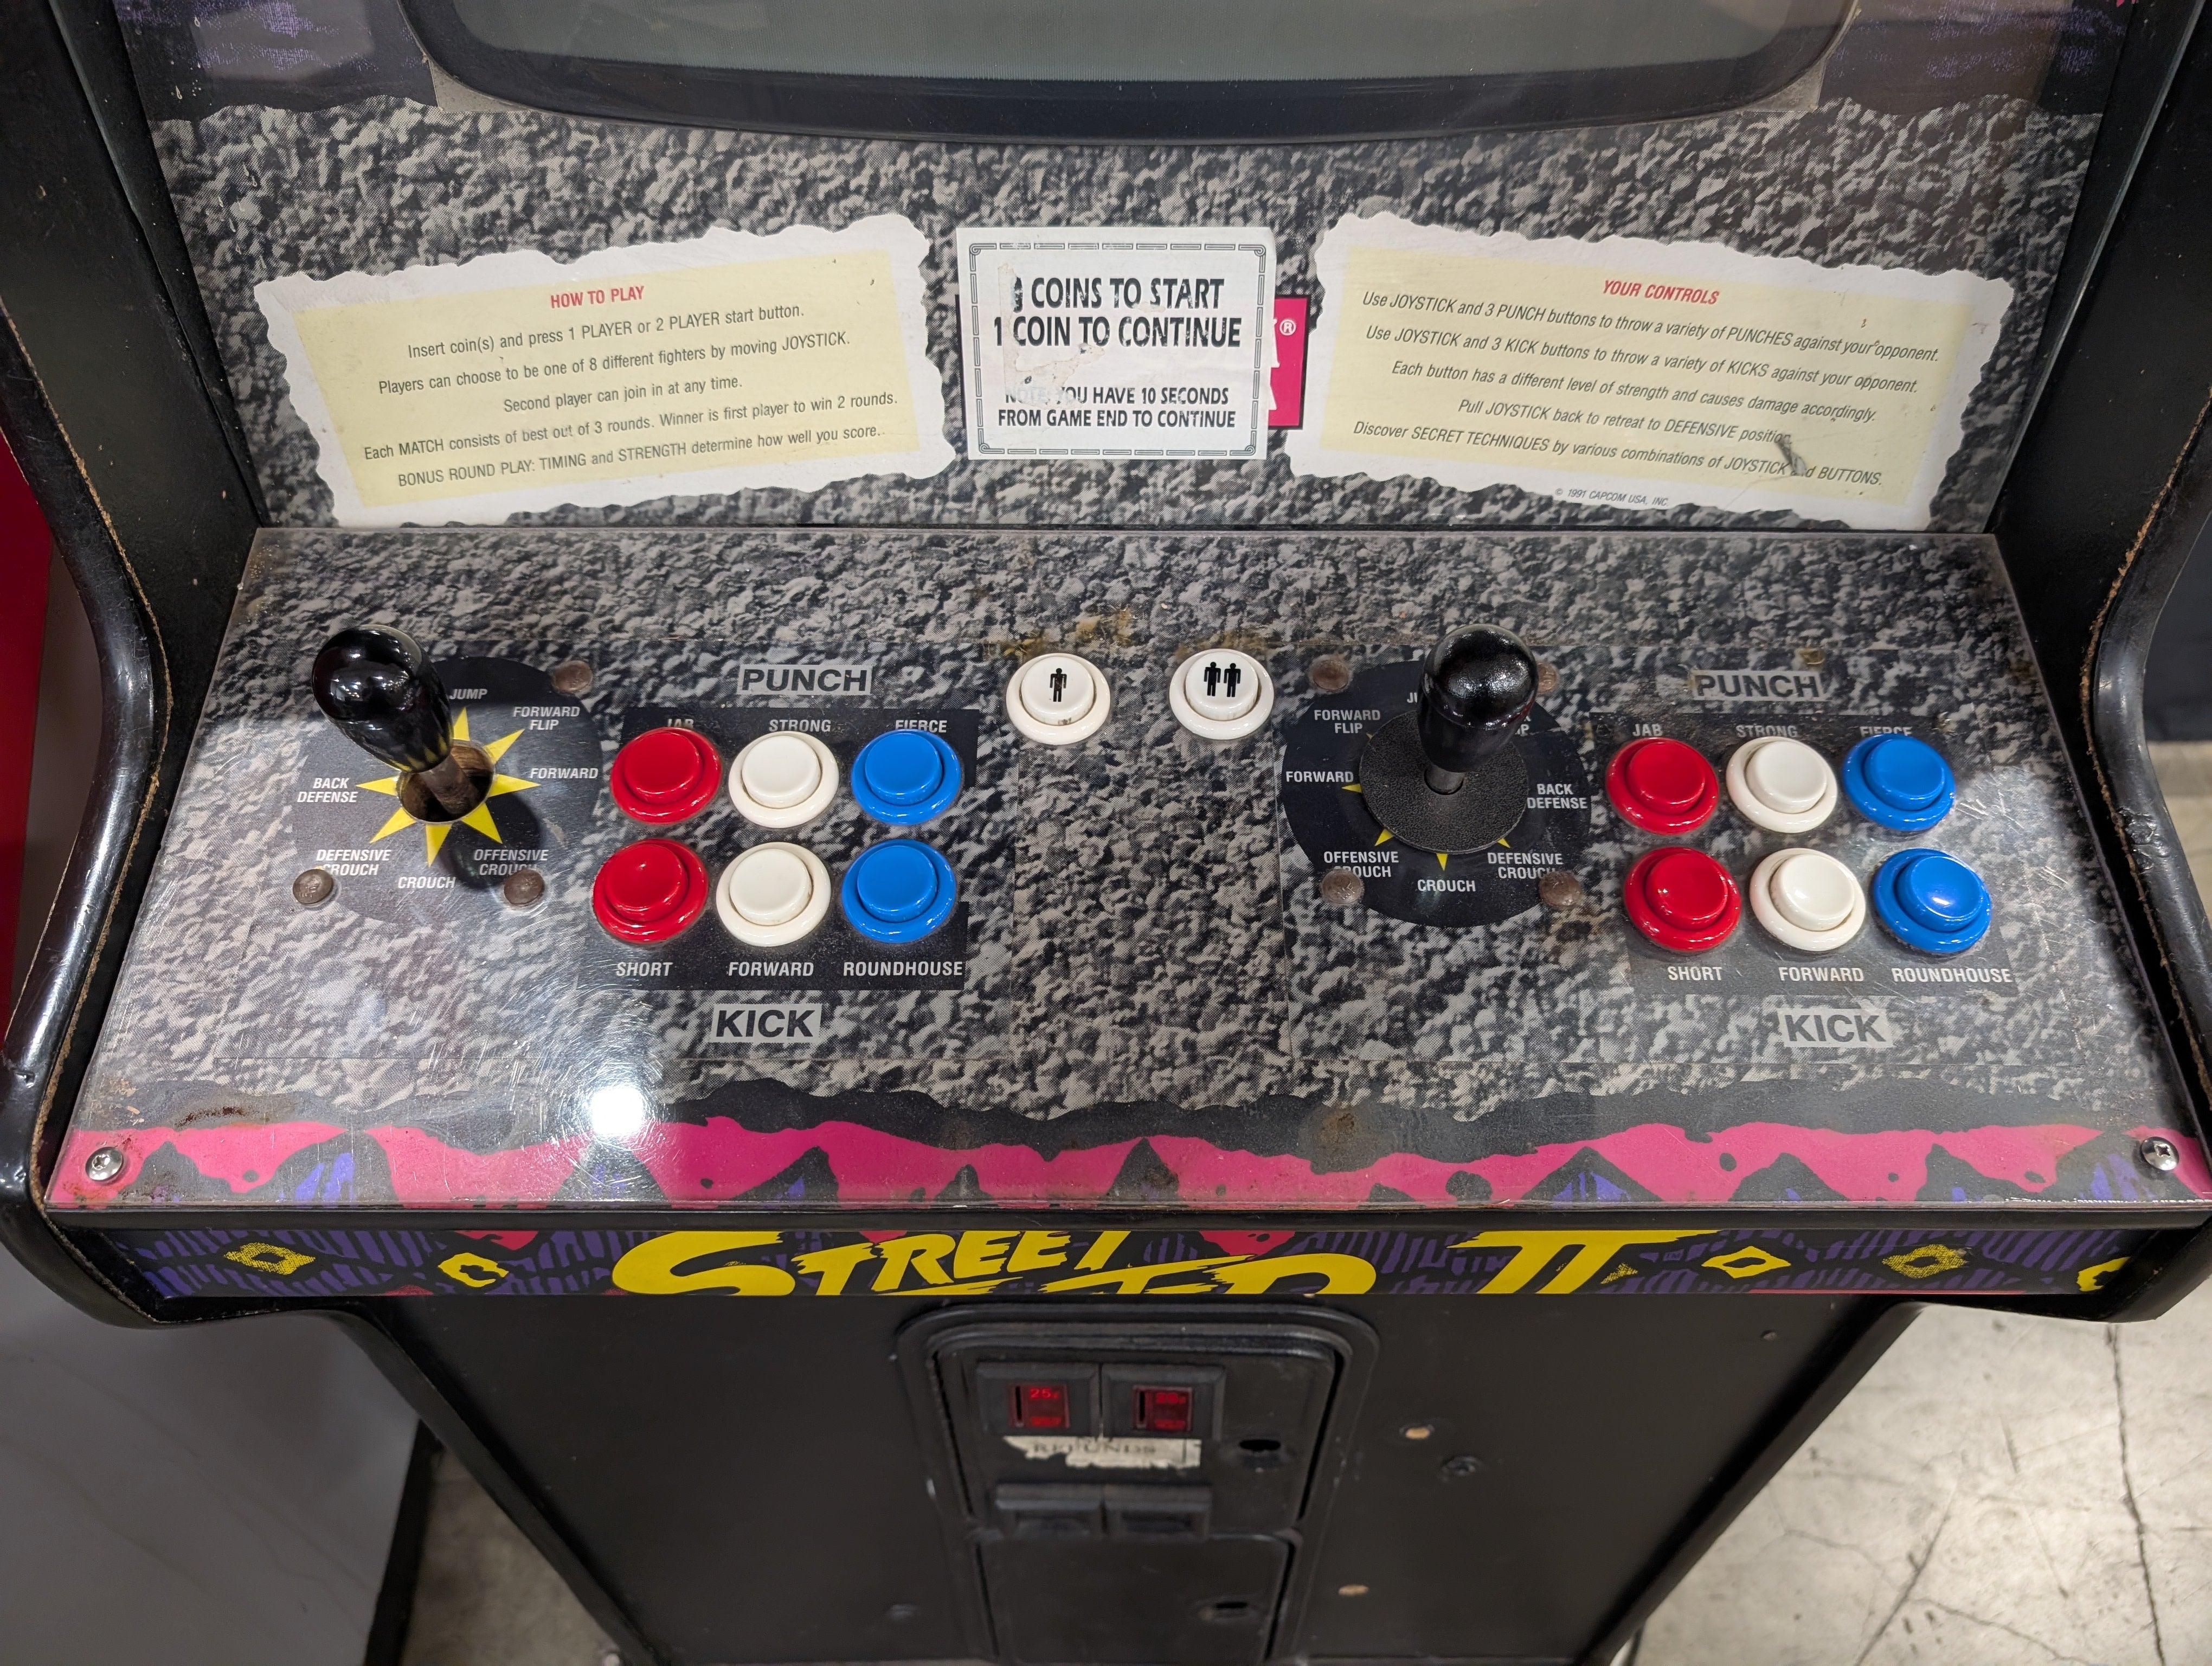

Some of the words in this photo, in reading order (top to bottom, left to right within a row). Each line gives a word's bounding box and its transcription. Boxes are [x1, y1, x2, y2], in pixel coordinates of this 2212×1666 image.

[551, 292, 583, 308] HOW
[587, 290, 605, 304] TO
[610, 286, 644, 302] PLAY
[1031, 277, 1102, 309] COINS
[1110, 278, 1140, 309] TO
[1149, 278, 1225, 309] START
[1603, 280, 1642, 297] YOUR
[1644, 284, 1719, 304] CONTROLS
[408, 342, 446, 358] Insert
[451, 336, 494, 353] coin(s)
[500, 333, 523, 348] and
[529, 331, 563, 348] press
[569, 327, 574, 340] 1
[582, 321, 632, 338] PLAYER
[638, 322, 651, 333] or
[657, 318, 664, 331] 2
[670, 312, 719, 330] PLAYER
[725, 309, 754, 324] start
[759, 306, 803, 320] button.
[994, 316, 1002, 347] 1
[1013, 316, 1071, 347] COIN
[1078, 316, 1110, 347] TO
[1118, 316, 1241, 348] CONTINUE
[1363, 291, 1387, 306] Use
[1390, 294, 1457, 313] JOYSTICK
[1457, 302, 1484, 315] and
[1485, 303, 1495, 316] 3
[1496, 304, 1546, 321] PUNCH
[1547, 309, 1597, 326] buttons
[1599, 315, 1612, 328] to
[1615, 316, 1654, 331] throw
[1654, 323, 1663, 332] a
[1666, 323, 1709, 340] variety
[1711, 326, 1727, 339] of
[1726, 327, 1793, 346] PUNCHES
[1793, 336, 1842, 351] against
[1841, 341, 1874, 356] your
[1875, 343, 1939, 362] opponent.
[379, 380, 424, 395] Players
[429, 377, 451, 388] can
[457, 371, 501, 386] choose
[506, 368, 518, 380] to
[524, 366, 538, 377] be
[544, 364, 567, 376] one
[573, 359, 584, 373] of
[589, 358, 597, 370] 8
[603, 353, 654, 369] different
[658, 349, 705, 366] fighters
[711, 345, 725, 360] by
[731, 340, 776, 356] moving
[782, 331, 850, 350] JOYSTICK.
[504, 395, 550, 412] Second
[556, 393, 592, 409] player
[597, 390, 619, 402] can
[625, 386, 646, 402] join
[652, 383, 663, 396] in
[668, 382, 679, 394] at
[684, 382, 706, 394] any
[711, 377, 742, 389] time.
[1093, 387, 1135, 405] HAVE
[1141, 387, 1156, 405] 10
[1161, 387, 1229, 405] SECONDS
[1392, 361, 1423, 376] Each
[1426, 364, 1468, 380] button
[1472, 368, 1495, 382] has
[1499, 374, 1507, 383] a
[1512, 373, 1564, 389] different
[1566, 377, 1597, 392] level
[1599, 381, 1616, 393] of
[1616, 383, 1669, 400] strength
[1672, 390, 1698, 402] and
[1700, 394, 1744, 407] causes
[1748, 396, 1798, 414] damage
[1801, 404, 1876, 423] accordingly.
[364, 445, 394, 459] Each
[399, 439, 443, 456] MATCH
[449, 434, 500, 450] consists
[505, 431, 517, 444] of
[523, 428, 548, 441] best
[553, 425, 573, 438] out
[578, 422, 589, 435] of
[595, 421, 602, 433] 3
[608, 416, 654, 432] rounds.
[659, 413, 704, 426] Winner
[709, 409, 718, 421] is
[724, 406, 747, 419] first
[753, 404, 789, 419] player
[794, 401, 805, 413] to
[811, 398, 832, 411] win
[838, 396, 845, 408] 2
[851, 392, 897, 407] rounds.
[999, 409, 1041, 427] FROM
[1047, 409, 1091, 427] GAME
[1097, 409, 1128, 427] END
[1133, 410, 1153, 427] TO
[1157, 410, 1236, 428] CONTINUE
[398, 470, 443, 486] BONUS
[449, 464, 495, 480] ROUND
[501, 460, 534, 475] PLAY:
[539, 453, 586, 470] TIMING
[591, 451, 613, 464] and
[619, 443, 686, 462] STRENGTH
[692, 437, 752, 453] determine
[758, 435, 783, 447] how
[788, 430, 811, 444] well
[816, 431, 838, 444] you
[843, 427, 880, 439] score.
[1568, 489, 1586, 498] 1991
[1589, 491, 1627, 502] CAPCOM
[741, 668, 868, 693] PUNCH
[1696, 674, 1821, 699] PUNCH
[448, 688, 487, 700] JUMP
[513, 706, 580, 718] FORWARD
[1314, 709, 1381, 721] FORWARD
[529, 719, 559, 731] FLIP
[768, 719, 832, 733] STRONG
[895, 720, 948, 733] FIERCE
[1334, 722, 1363, 734] FLIP
[1632, 724, 1663, 737] JAB
[1735, 725, 1798, 738] STRONG
[529, 767, 599, 779] FORWARD
[1285, 771, 1354, 783] FORWARD
[312, 777, 349, 789] BACK
[1536, 784, 1573, 796] BACK
[297, 791, 358, 803] DEFENSE
[1527, 797, 1587, 809] DEFENSE
[316, 849, 391, 861] DEFENSIVE
[473, 849, 549, 861] OFFENSIVE
[1323, 851, 1399, 863] OFFENSIVE
[1487, 852, 1564, 865] DEFENSIVE
[479, 864, 537, 876] CROU
[1334, 866, 1392, 878] OUCH
[397, 876, 456, 889] CROUCH
[1417, 879, 1476, 892] CROUCH
[615, 962, 673, 977] SHORT
[727, 962, 815, 977] FORWARD
[843, 960, 963, 977] ROUNDHOUSE
[1668, 966, 1723, 981] SHORT
[1778, 967, 1864, 982] FORWARD
[1891, 967, 2012, 983] ROUNDHOUSE
[715, 1009, 816, 1038] KICK
[1784, 1014, 1886, 1043] KICK
